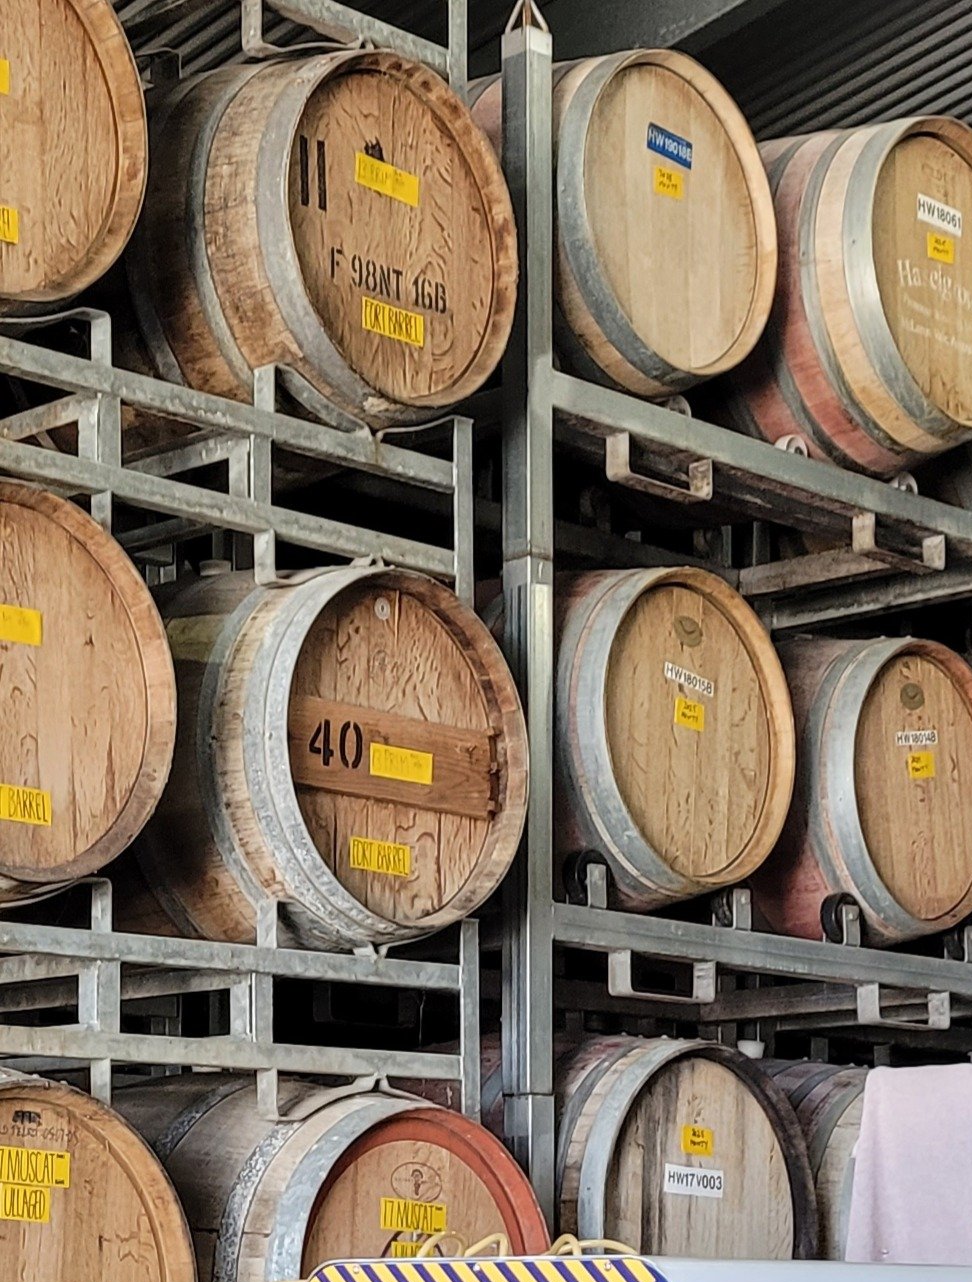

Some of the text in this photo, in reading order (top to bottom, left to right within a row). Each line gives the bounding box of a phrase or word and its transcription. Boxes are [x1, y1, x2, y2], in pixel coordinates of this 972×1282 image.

[918, 198, 961, 229] HW18061
[330, 246, 343, 279] F
[351, 253, 403, 302] 98NT
[388, 306, 422, 344] BARREL
[308, 718, 363, 769] 40
[8, 787, 48, 822] BARREL
[376, 843, 409, 875] BARREL
[7, 1149, 55, 1184] MUSCAT
[667, 1170, 722, 1191] HW17V003
[4, 1187, 46, 1220] ULLAGED
[384, 1199, 395, 1228] 17
[396, 1201, 435, 1232] MUSCAT
